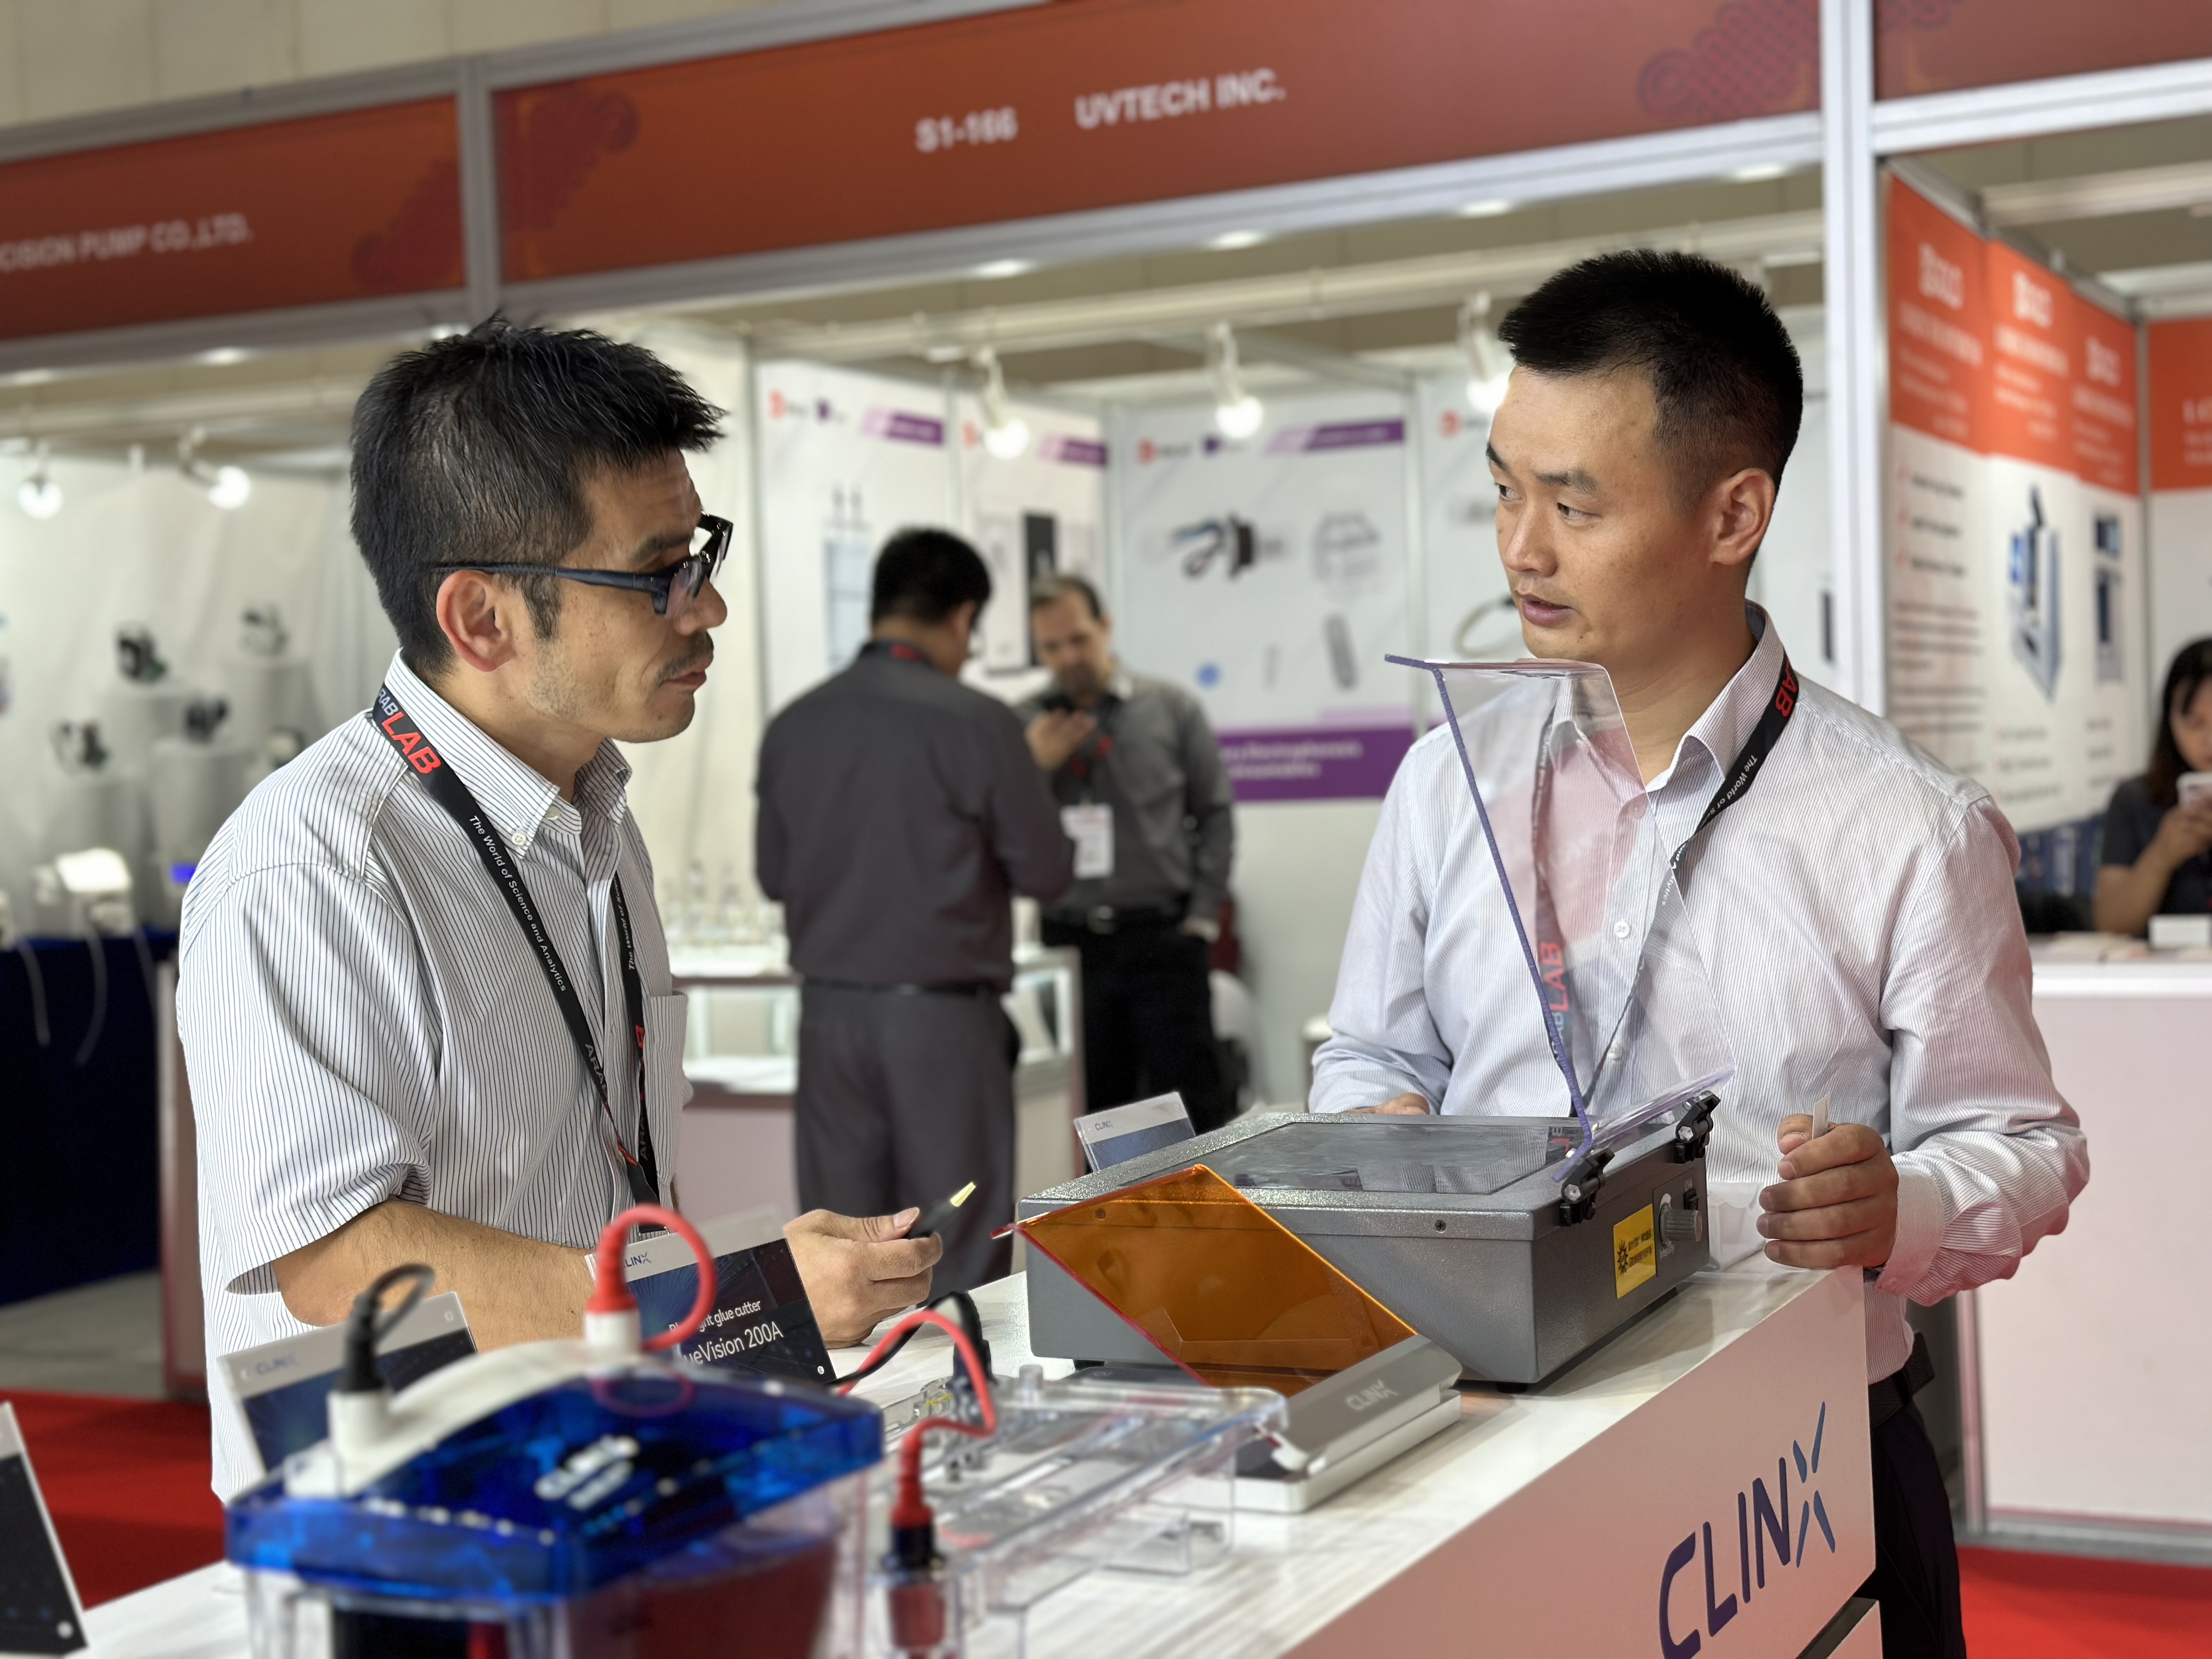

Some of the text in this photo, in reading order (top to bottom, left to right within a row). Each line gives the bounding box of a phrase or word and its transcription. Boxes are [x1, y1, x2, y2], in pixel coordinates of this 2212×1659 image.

[915, 68, 1286, 153] S1-166 UVTECH INC.
[78, 223, 148, 261] PUMP
[1717, 755, 1758, 809] The World of
[469, 815, 566, 992] The World of Science and Analytics
[618, 904, 624, 917] of
[621, 918, 631, 949] World
[1094, 1119, 1114, 1131] CLINX
[624, 1251, 652, 1269] LINX
[714, 1308, 735, 1327] glue
[735, 1300, 762, 1317] cutter
[744, 1321, 785, 1348] 200A
[1345, 1379, 1400, 1411] CLINX
[1659, 1401, 1836, 1659] CLINX
